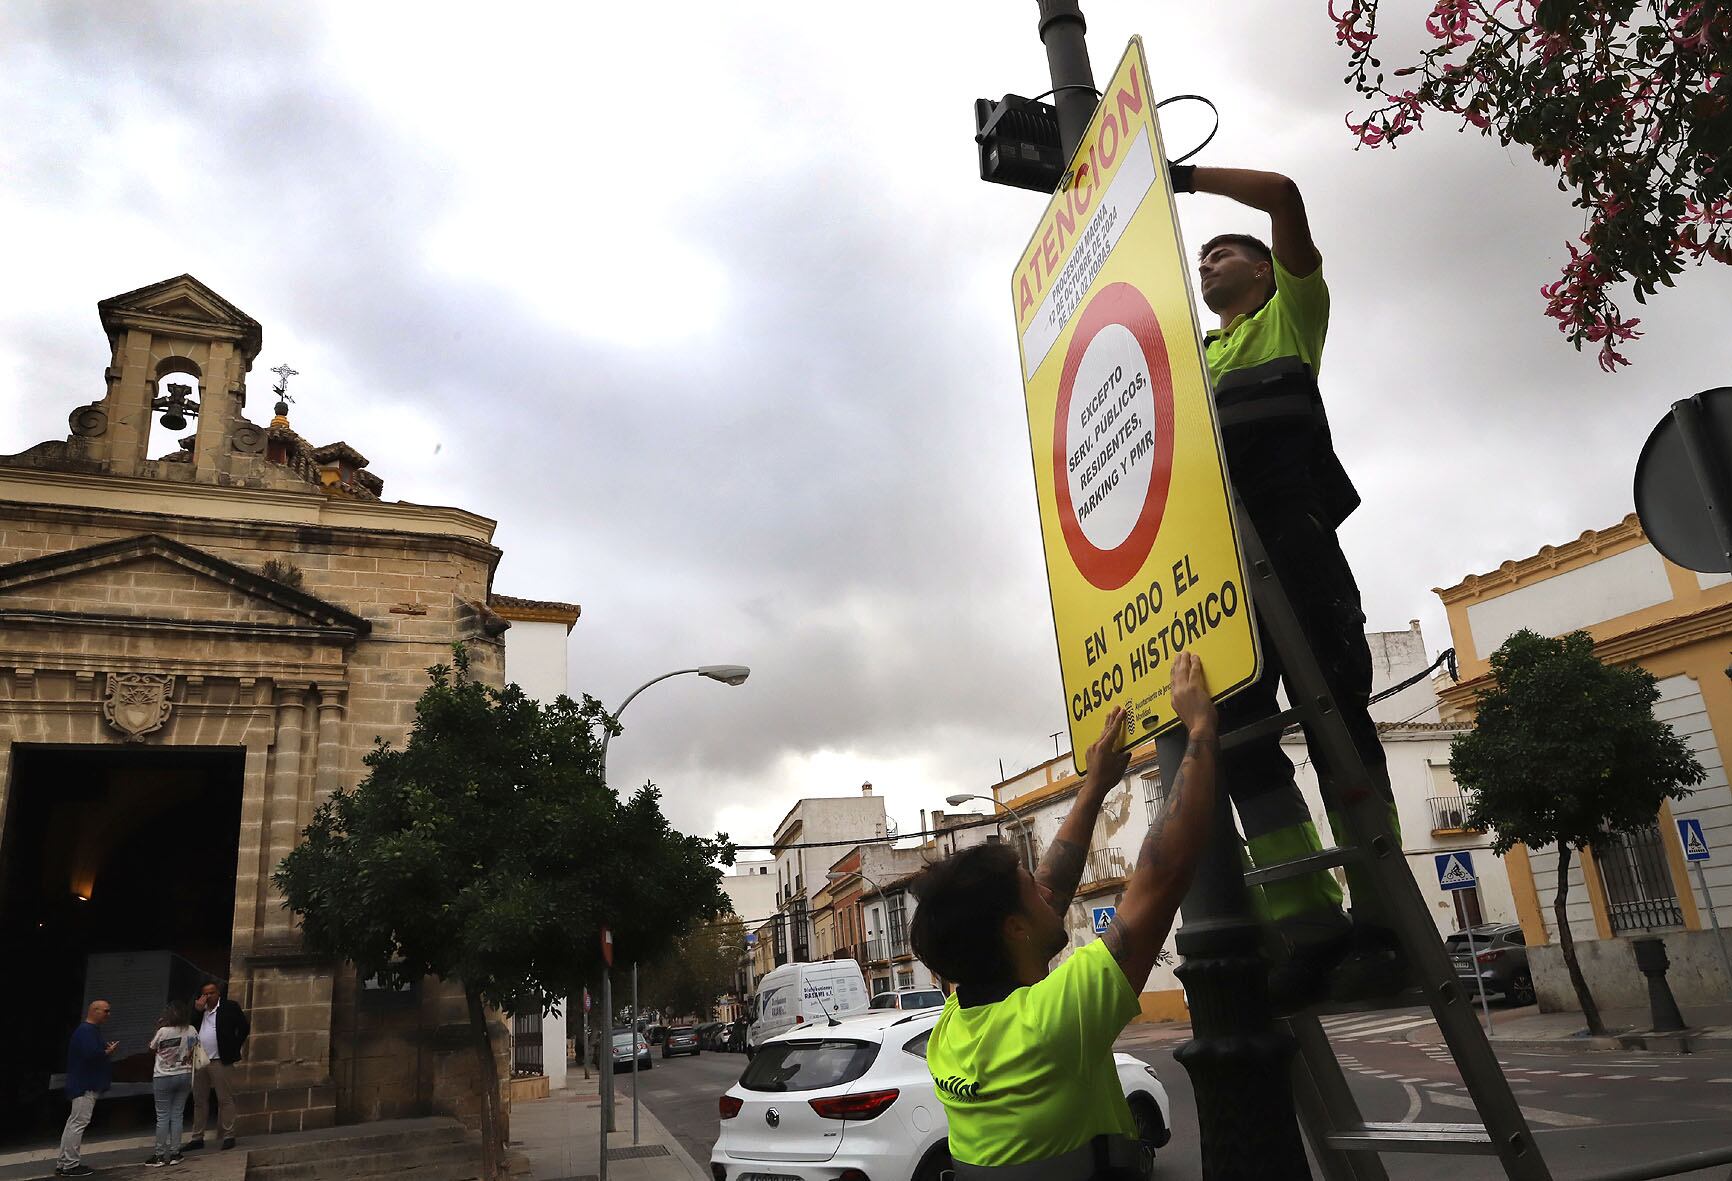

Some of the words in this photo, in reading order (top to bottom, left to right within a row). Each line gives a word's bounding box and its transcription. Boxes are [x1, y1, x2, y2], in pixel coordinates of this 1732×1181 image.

[1020, 63, 1143, 323] ATENCIÓN
[1049, 309, 1056, 327] 12
[1055, 296, 1065, 316] DE
[1064, 249, 1092, 300] OCTUBRE
[1092, 234, 1102, 256] DE
[1101, 205, 1118, 244] 2024
[1052, 241, 1085, 303] PROCESIÓN
[1084, 203, 1108, 251] MAGNA
[1058, 310, 1068, 329] DE
[1067, 300, 1075, 316] 14
[1075, 290, 1081, 305] A
[1080, 276, 1089, 296] 02
[1088, 239, 1111, 283] HORAS
[1068, 435, 1094, 473] SERV.
[1094, 371, 1147, 442] PÚBLICOS,
[1080, 365, 1122, 428] EXCEPTO
[1078, 468, 1119, 524] PARKING
[1120, 457, 1127, 475] Y
[1130, 430, 1154, 467] PMR
[1080, 412, 1142, 491] RESIDENTES,
[1072, 663, 1124, 722] CASCO
[1129, 580, 1238, 683] HISTÓRICO
[1084, 625, 1108, 667] EN
[1113, 581, 1163, 642] TODO
[1172, 554, 1199, 597] EL
[1157, 688, 1163, 697] de
